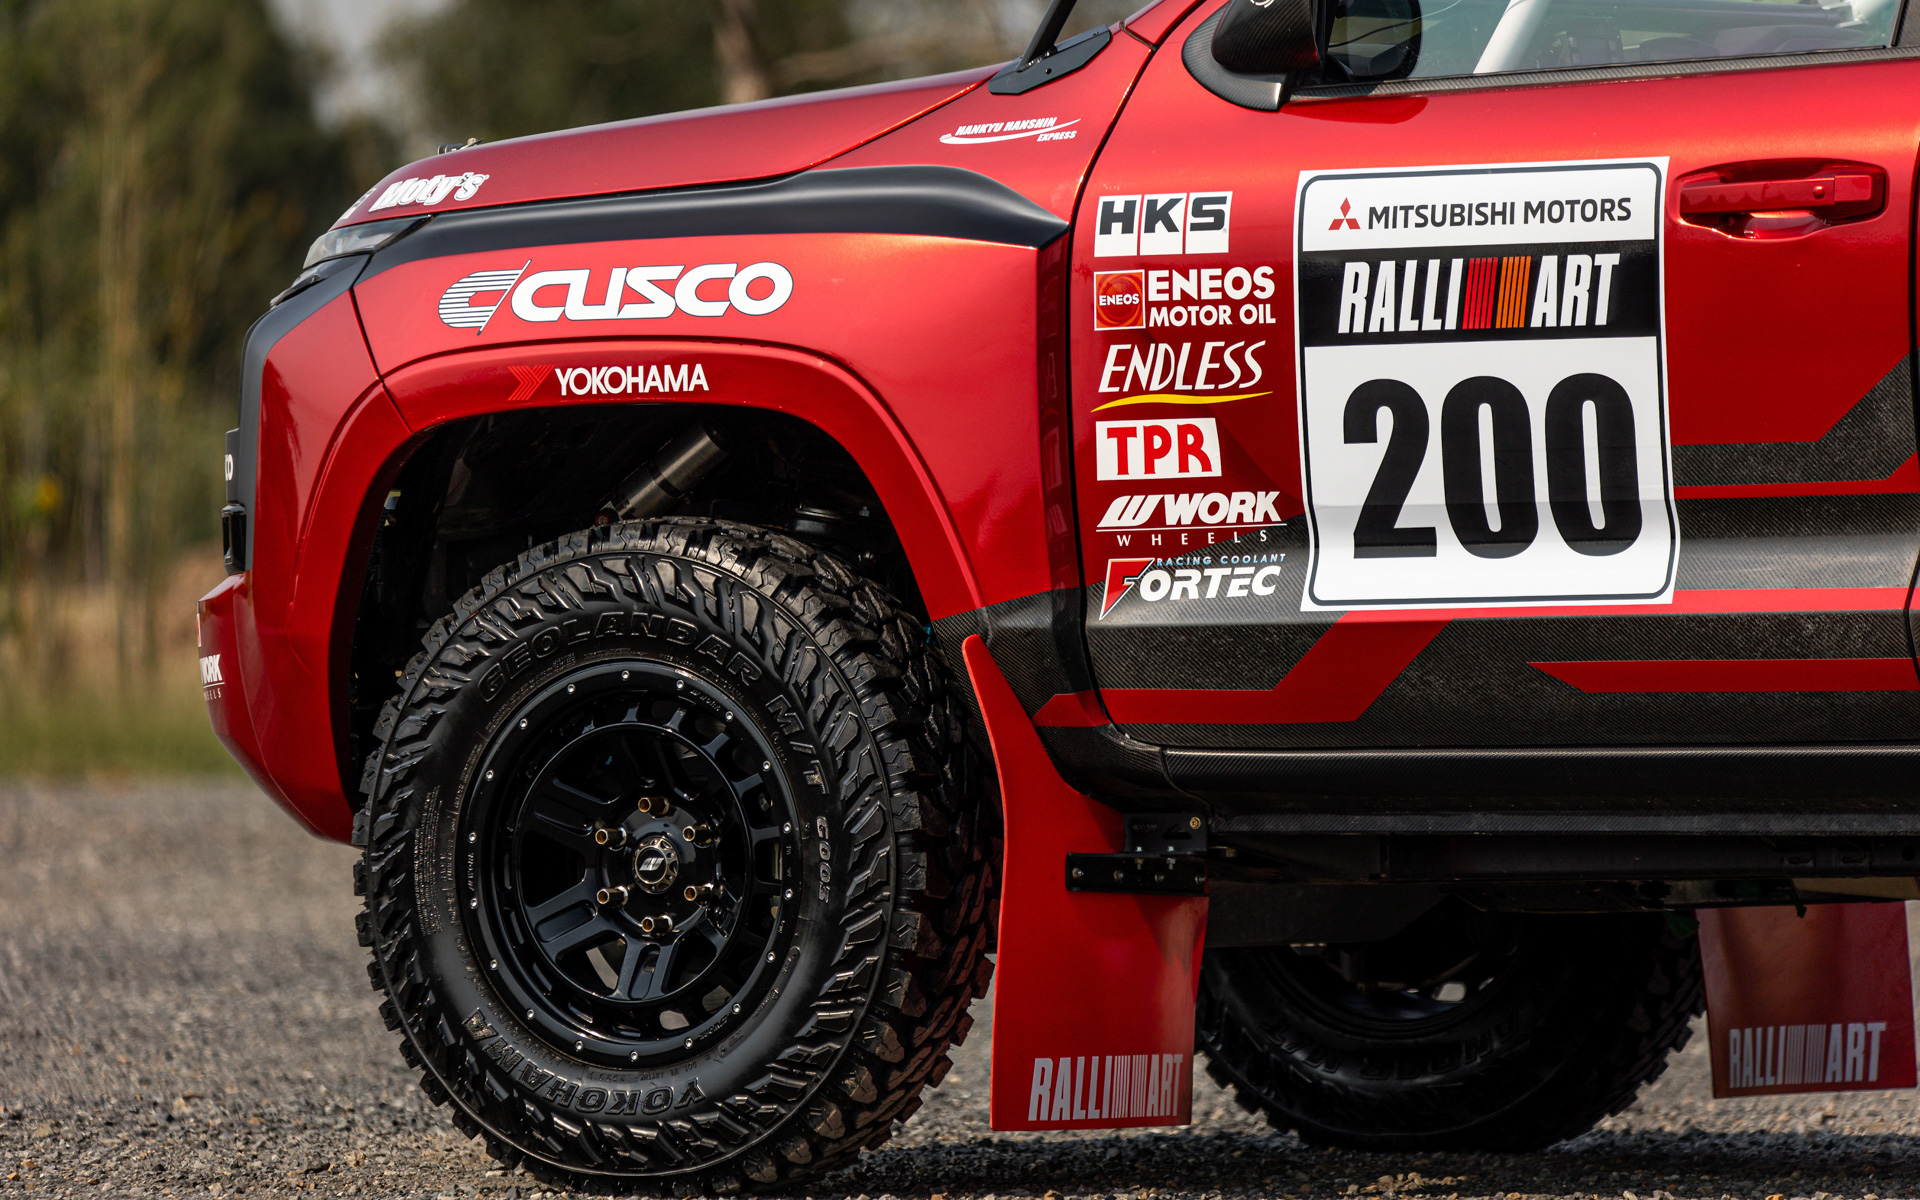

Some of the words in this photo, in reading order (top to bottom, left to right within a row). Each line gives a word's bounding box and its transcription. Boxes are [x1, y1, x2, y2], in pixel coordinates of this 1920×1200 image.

[955, 121, 1004, 136] HANKYU
[1003, 116, 1058, 132] HANSHIN
[1036, 130, 1078, 142] EXPRESS
[368, 172, 490, 213] Moty's
[1098, 194, 1229, 236] HKS
[1368, 201, 1516, 230] MITSUBISHI
[1523, 197, 1632, 225] MOTORS
[510, 261, 794, 323] CUSCO
[1099, 293, 1140, 306] ENEOS
[1148, 265, 1276, 302] ENEOS
[1148, 304, 1233, 328] MOTOR
[1239, 303, 1277, 325] OIL
[555, 363, 710, 396] YOKOHAMA
[1097, 340, 1267, 393] ENDLESS
[1106, 423, 1213, 476] TPR
[1343, 372, 1643, 559] 200
[1163, 490, 1282, 526] WORK
[1116, 529, 1267, 547] WHEELS
[1156, 556, 1212, 567] RACING
[1220, 553, 1287, 565] COOLANT
[478, 611, 763, 703] GEOLANDAR
[816, 815, 832, 904] G003
[461, 1007, 705, 1116] YOKOHAMA
